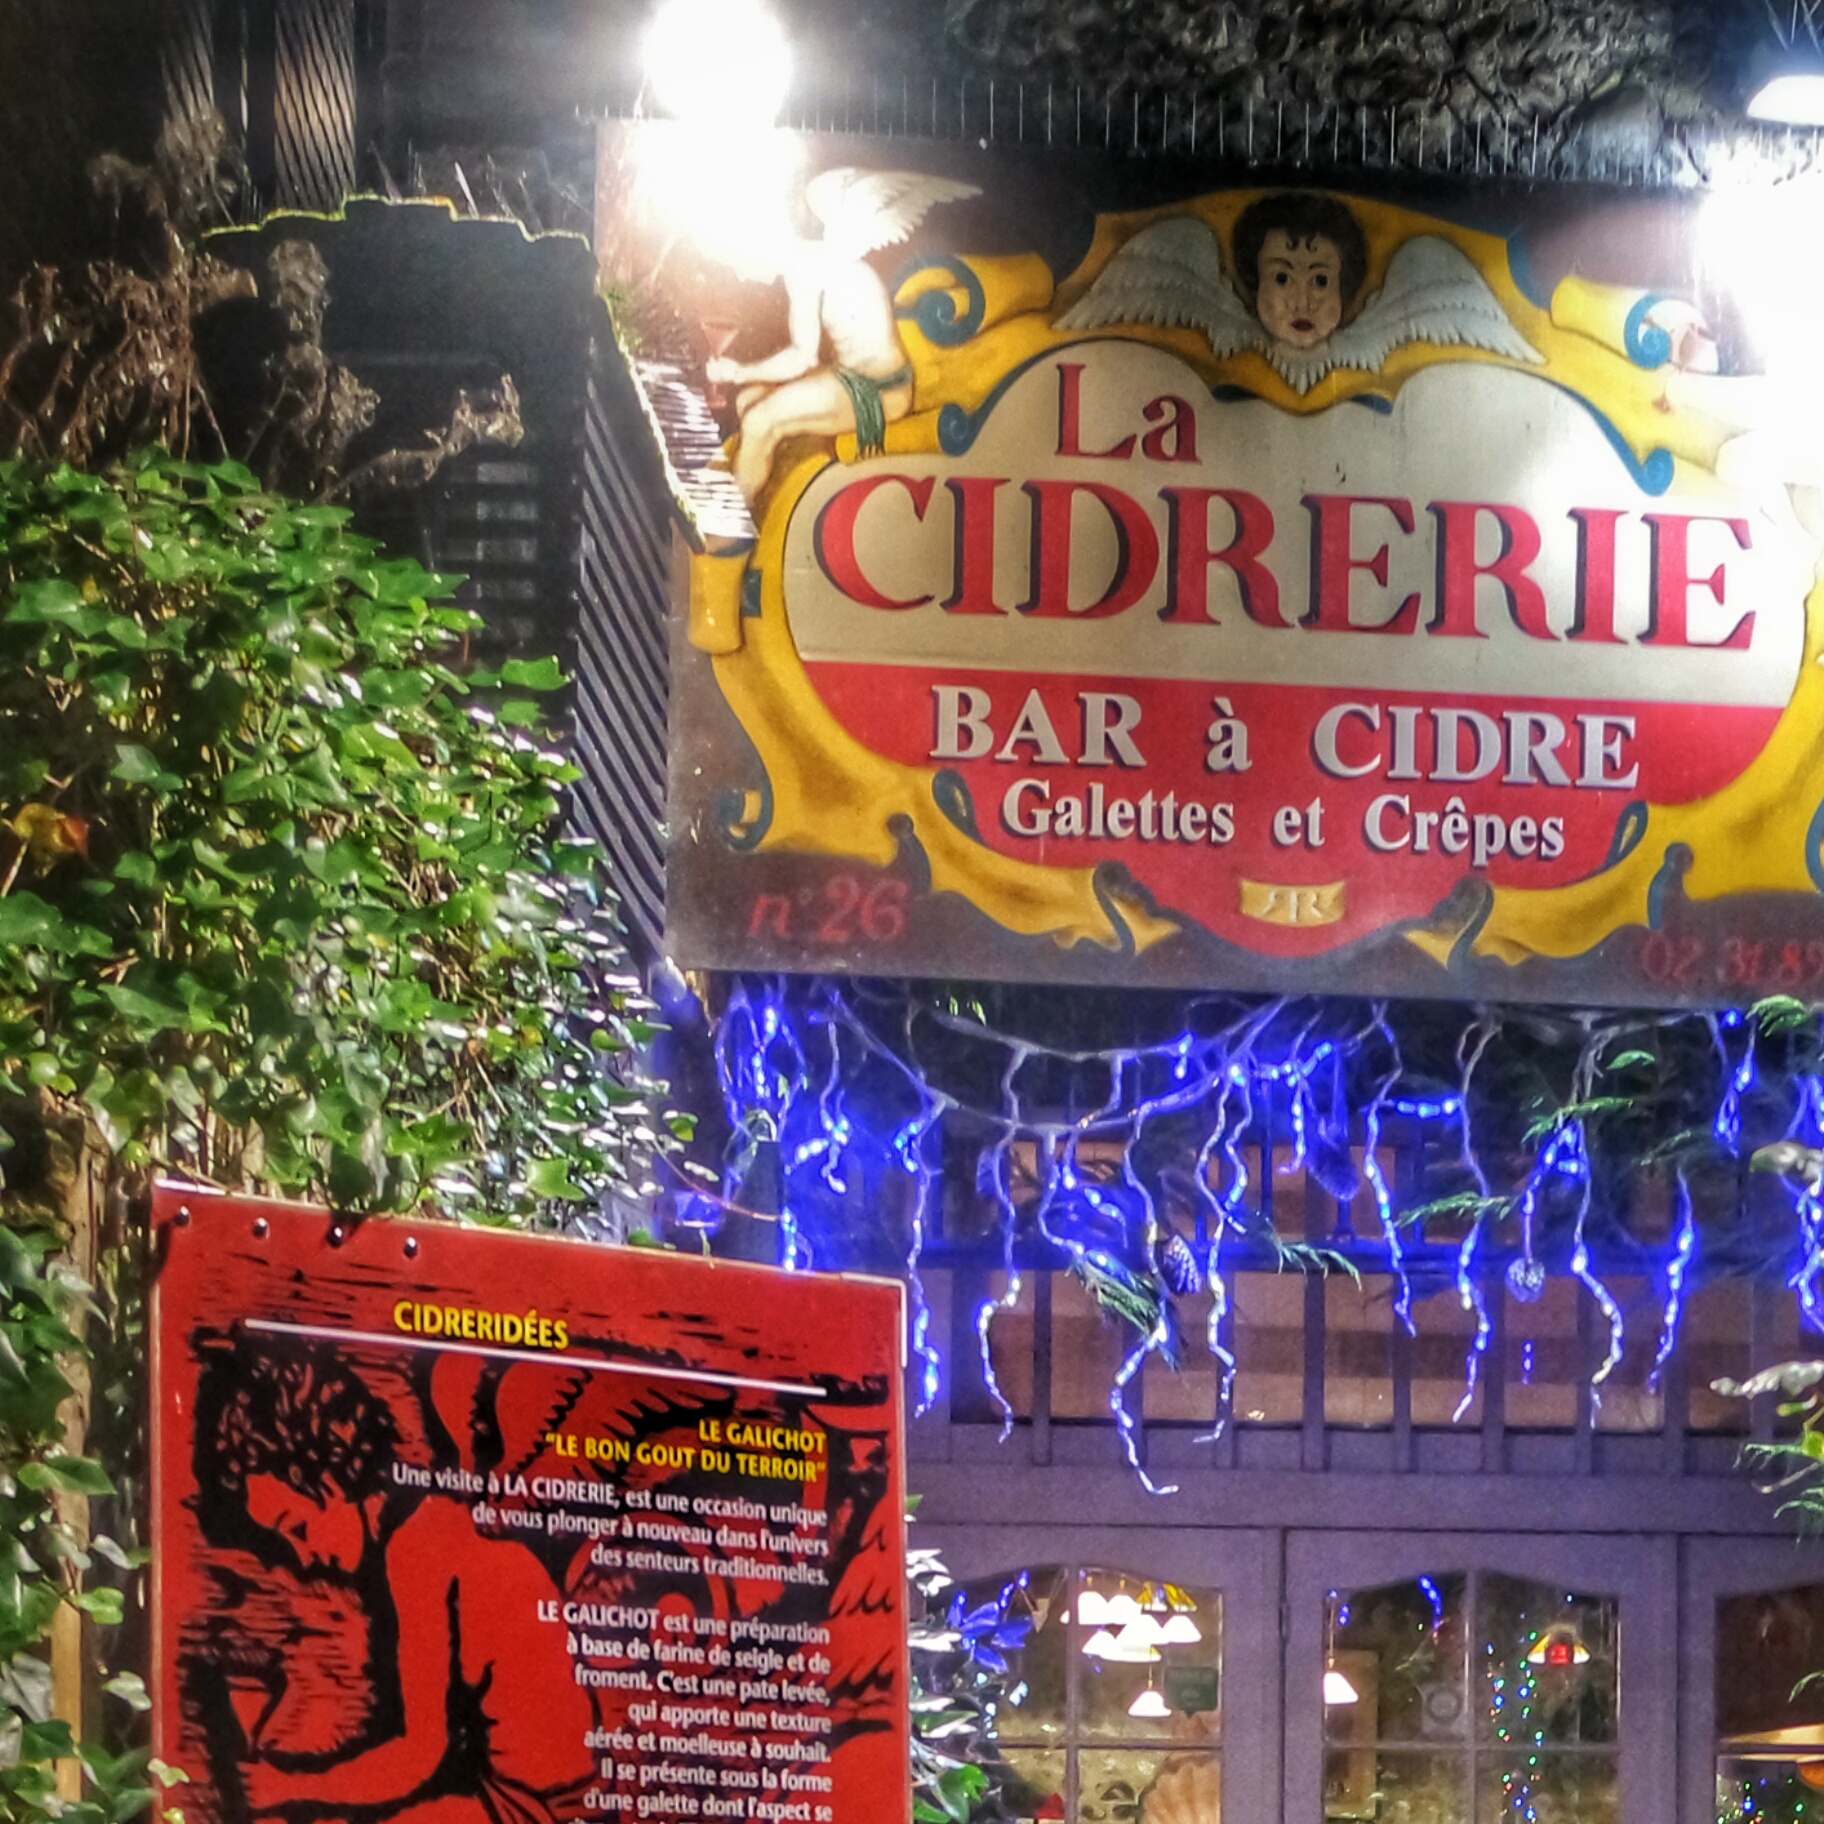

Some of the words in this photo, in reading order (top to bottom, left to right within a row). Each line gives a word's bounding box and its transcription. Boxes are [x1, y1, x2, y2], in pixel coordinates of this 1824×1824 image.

[1055, 364, 1200, 464] La
[813, 474, 1755, 651] CIDRERIE
[928, 684, 1147, 768] BAR
[1206, 696, 1252, 774] à
[1312, 702, 1640, 791] CIDRE
[1002, 777, 1235, 846] Galettes
[1273, 796, 1325, 850] et
[1364, 793, 1566, 867] Crêpes
[819, 875, 908, 941] 26
[393, 1301, 569, 1350] CIDRERIDÉES
[584, 1436, 630, 1463] BON
[636, 1442, 696, 1469] GOUT
[700, 1448, 731, 1474] DU
[698, 1419, 722, 1443] LE
[726, 1422, 827, 1454] GALICHOT
[392, 1461, 432, 1488] Une
[434, 1466, 484, 1493] visite
[487, 1471, 500, 1494] à
[503, 1473, 529, 1498] LA
[624, 1488, 652, 1510] est
[655, 1493, 690, 1513] une
[692, 1496, 767, 1521] occasion
[769, 1501, 828, 1532] unique
[471, 1500, 497, 1525] de
[499, 1508, 544, 1530] vous
[546, 1508, 619, 1541] plonger
[621, 1514, 634, 1538] à
[636, 1521, 713, 1546] nouveau
[714, 1523, 758, 1550] dans
[537, 1598, 560, 1623] LE
[562, 1601, 661, 1631] GALICHOT
[662, 1612, 690, 1634] est
[692, 1616, 728, 1637] une
[729, 1615, 831, 1646] préparation
[701, 1678, 737, 1697] une
[739, 1679, 780, 1704] pate
